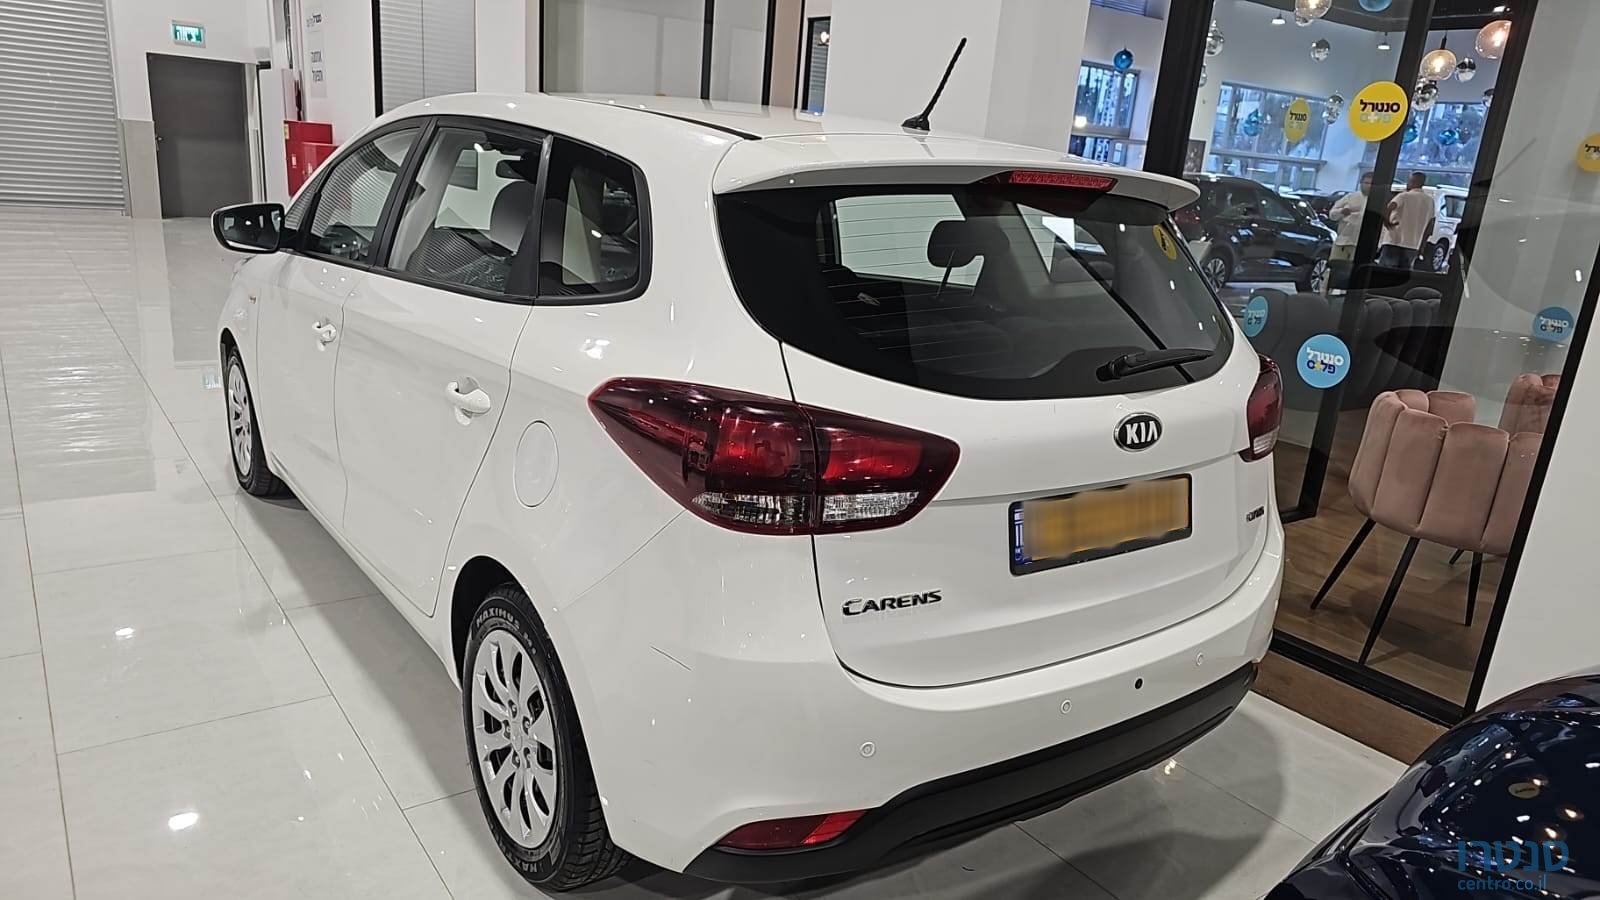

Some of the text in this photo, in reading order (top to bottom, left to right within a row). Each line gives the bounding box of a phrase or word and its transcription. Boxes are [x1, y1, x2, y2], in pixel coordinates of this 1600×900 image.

[1360, 100, 1401, 113] סנטרל
[1306, 347, 1345, 366] סנטרל
[1125, 421, 1158, 444] KIA
[842, 590, 942, 616] CARENS
[476, 607, 520, 630] MAXIMUS
